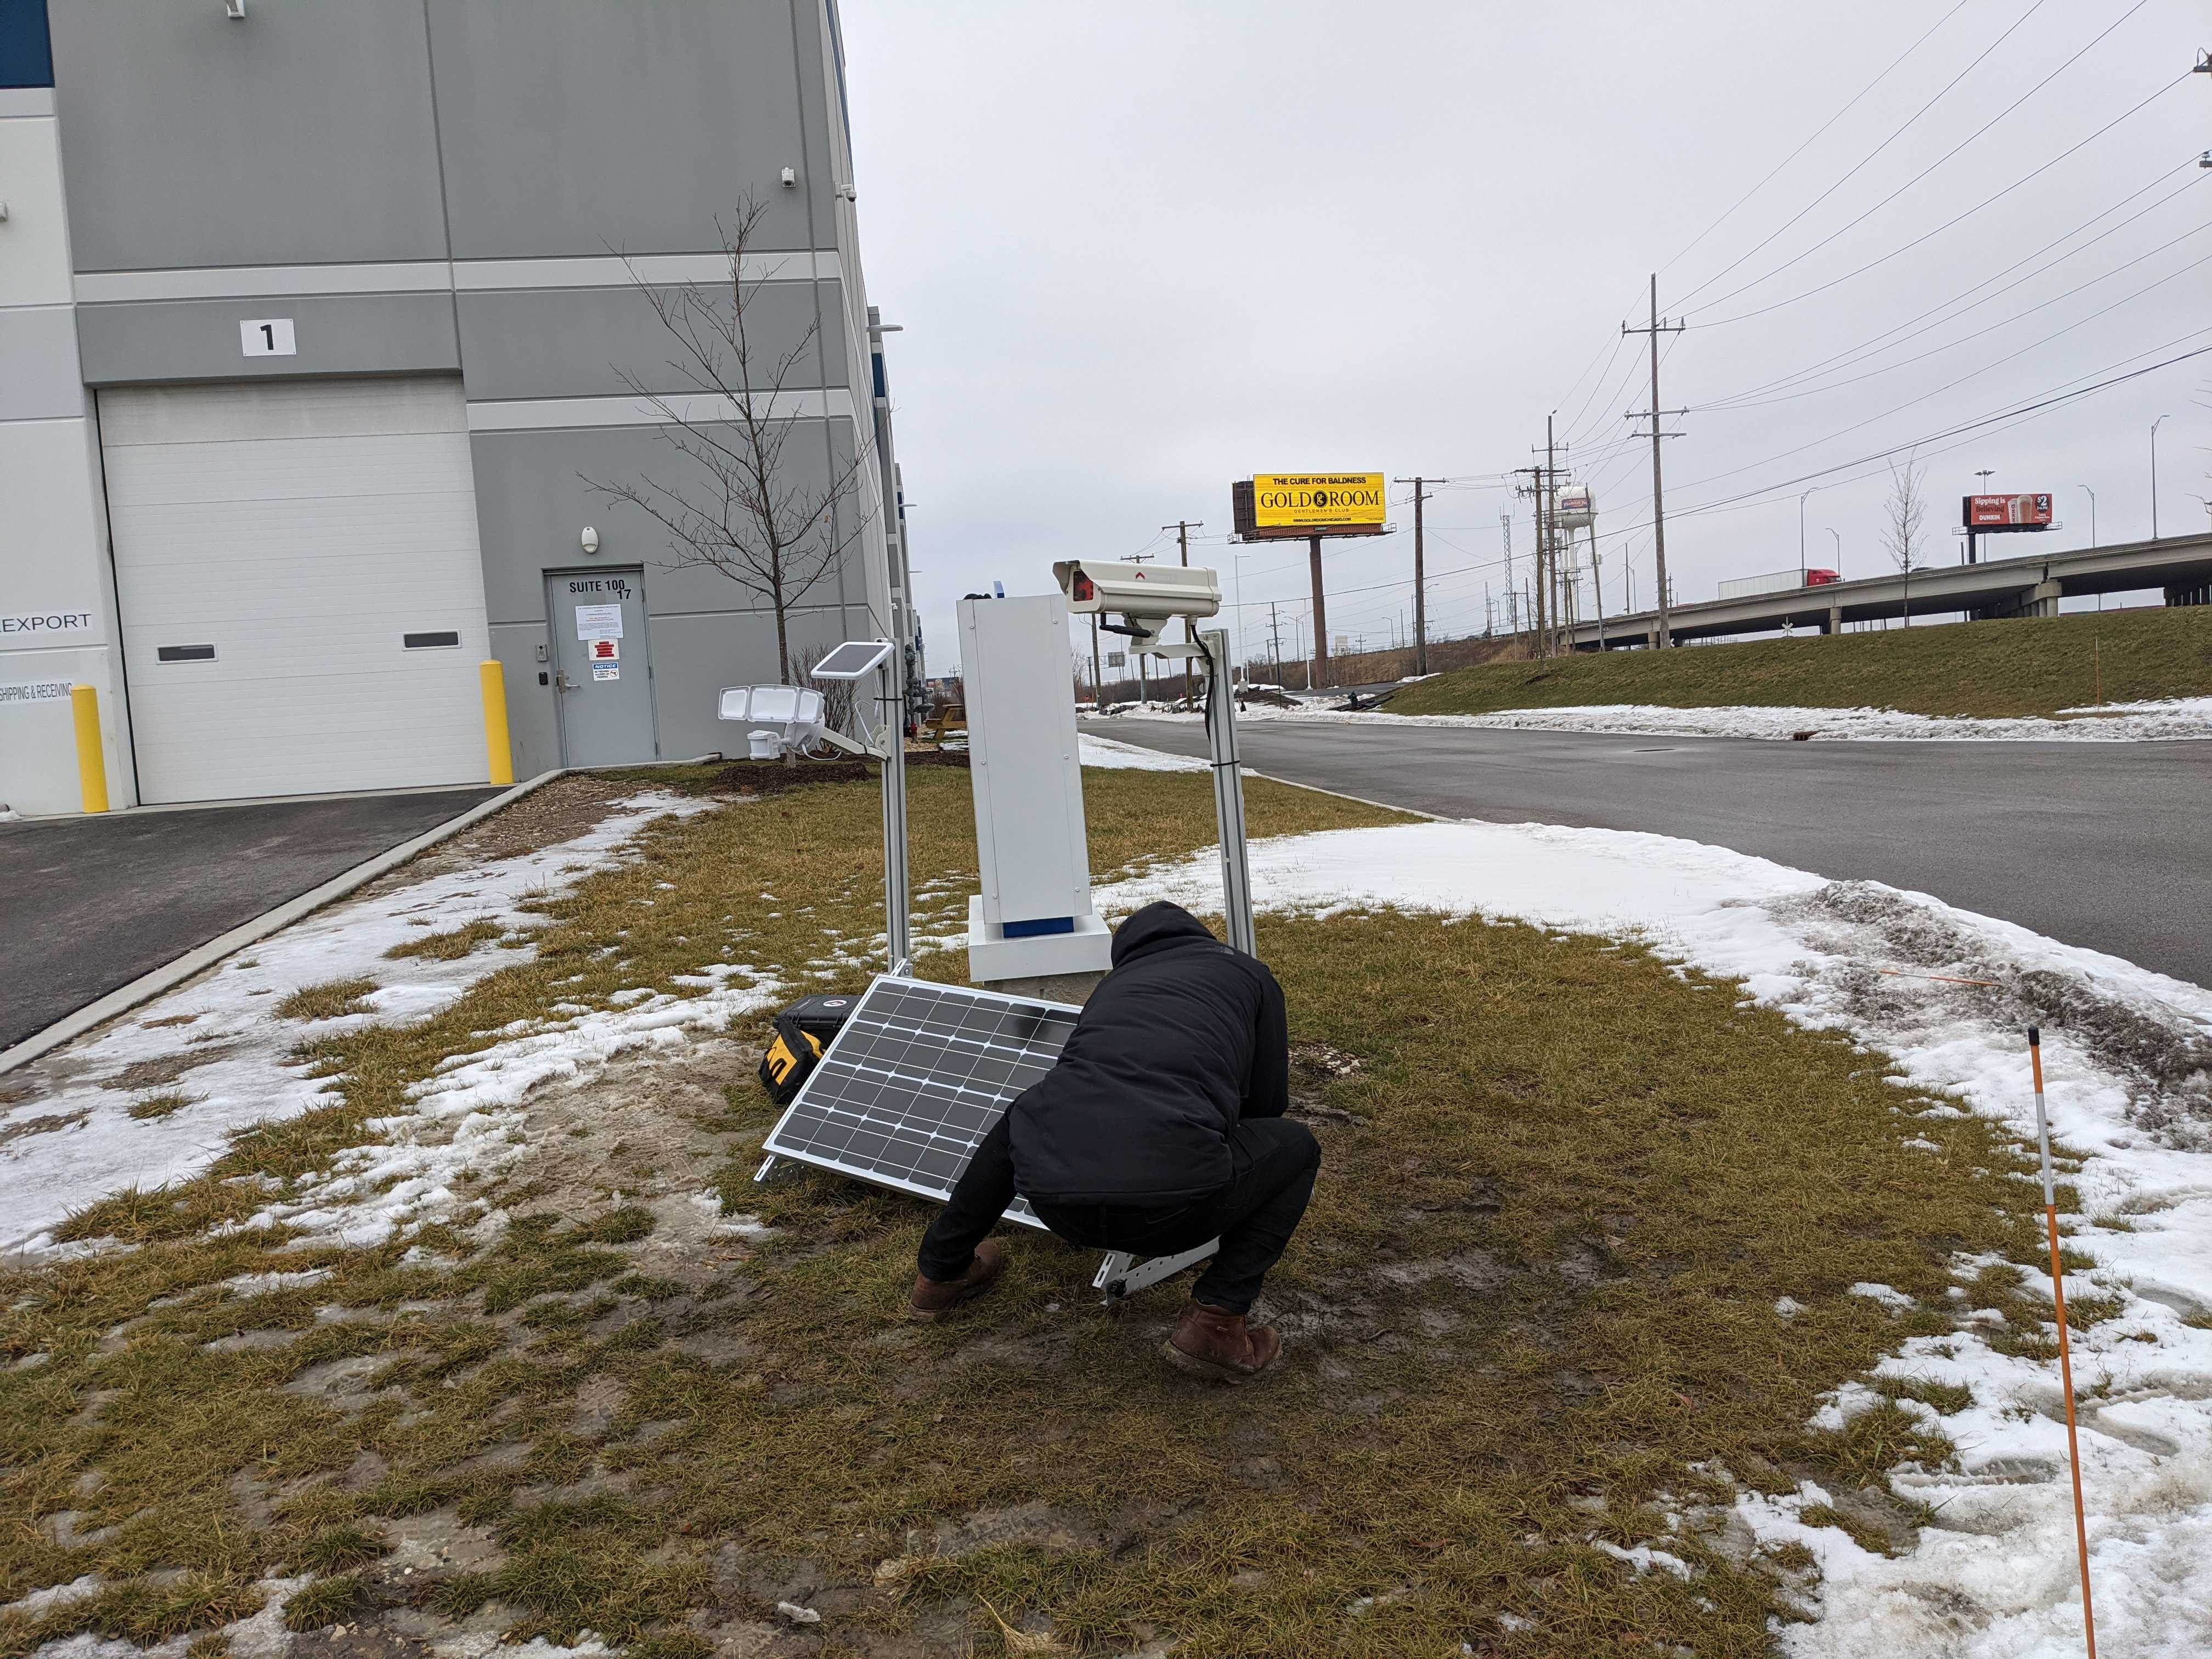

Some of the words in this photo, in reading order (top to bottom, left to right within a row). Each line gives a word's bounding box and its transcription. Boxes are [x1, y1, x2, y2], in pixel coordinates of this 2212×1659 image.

[260, 324, 274, 350] 1
[1261, 492, 1312, 508] GOLD
[1329, 490, 1379, 506] ROOM
[1975, 497, 1999, 505] Sipping
[2037, 495, 2047, 506] $2
[569, 581, 602, 592] SUITE
[605, 579, 625, 590] 100
[617, 589, 631, 600] 17
[0, 614, 91, 632] EXPORT
[0, 686, 30, 701] SHIPPING
[31, 685, 36, 699] &
